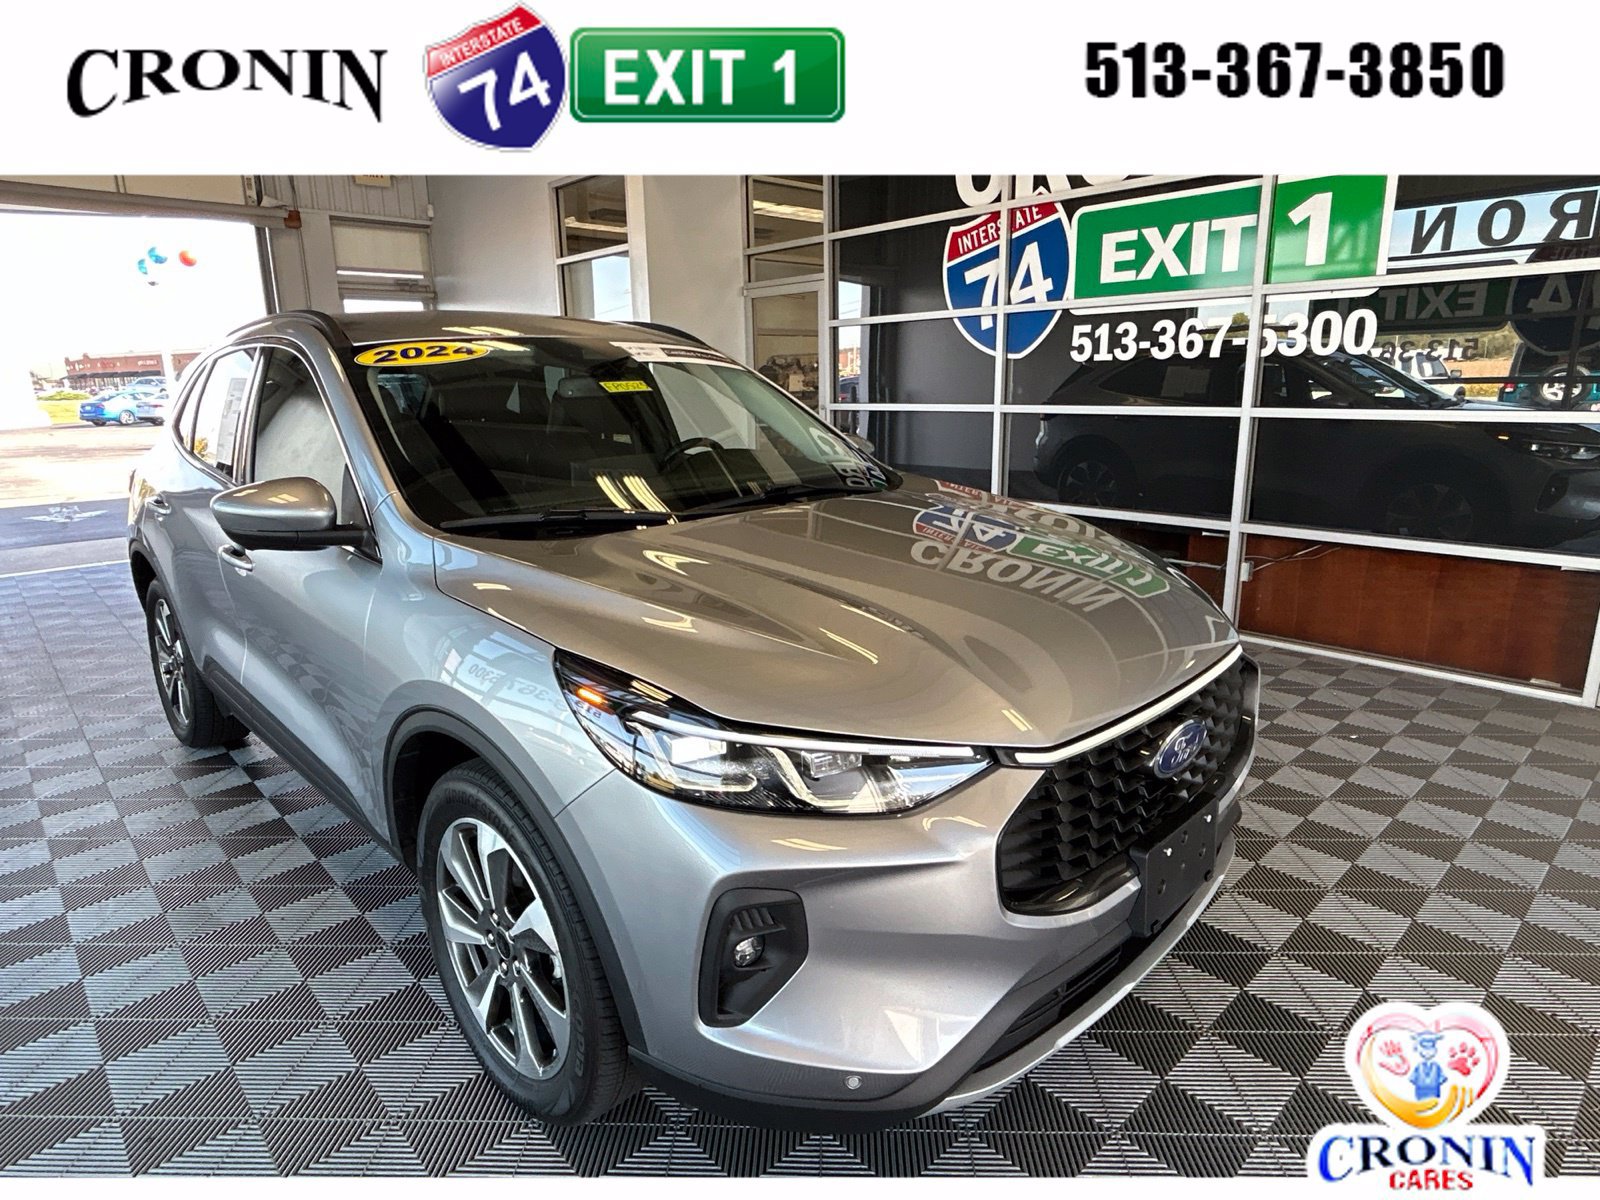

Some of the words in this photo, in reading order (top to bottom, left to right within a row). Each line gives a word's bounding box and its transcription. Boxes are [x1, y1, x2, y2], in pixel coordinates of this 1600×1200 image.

[957, 205, 1042, 254] INTERSATE
[1100, 214, 1258, 284] EXIT
[1287, 191, 1333, 266] 1
[964, 241, 1054, 331] 74
[373, 345, 478, 364] 2024
[1069, 309, 1378, 363] 513-367-5300
